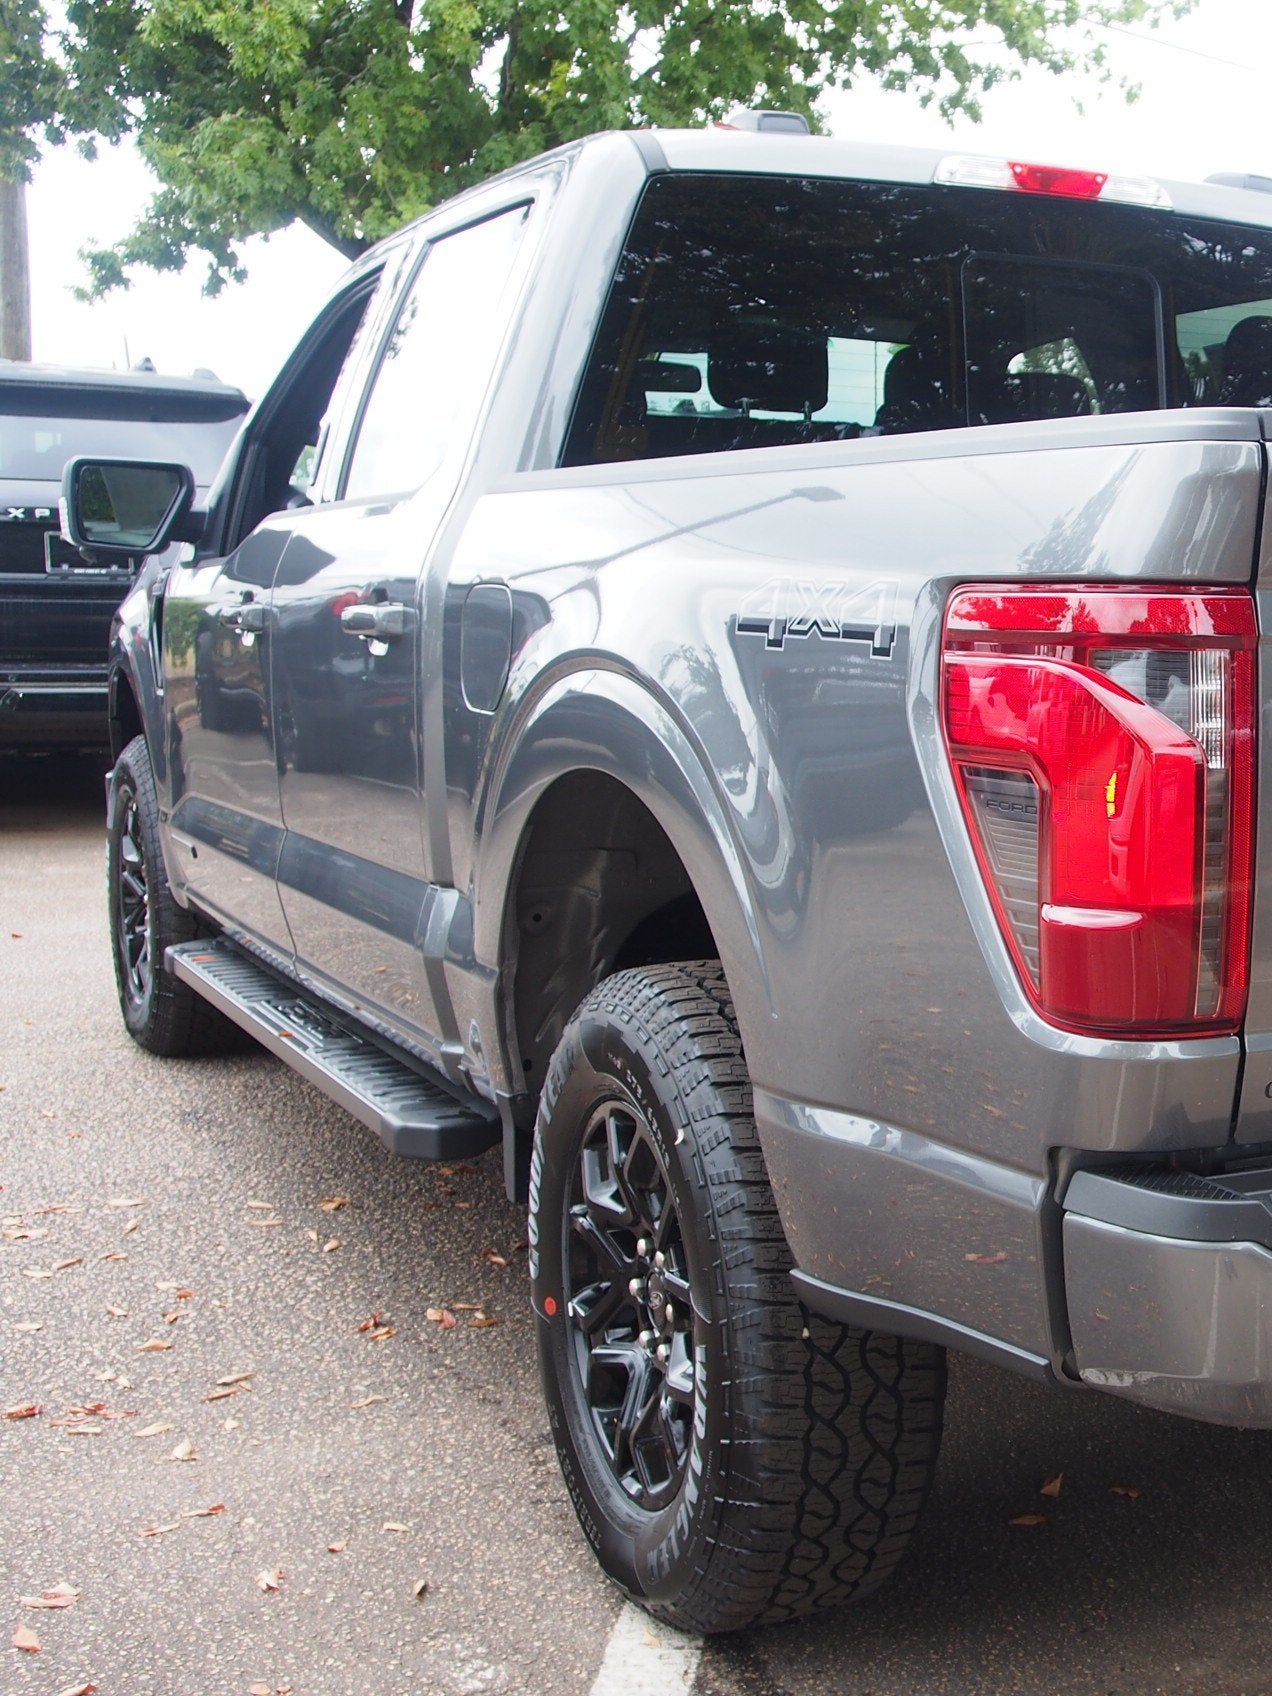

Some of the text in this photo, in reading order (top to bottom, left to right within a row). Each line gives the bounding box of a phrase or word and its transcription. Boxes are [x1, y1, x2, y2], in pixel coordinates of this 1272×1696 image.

[736, 576, 900, 660] 4X4
[985, 799, 1038, 815] FORD
[647, 1345, 707, 1582] WRANGLER
